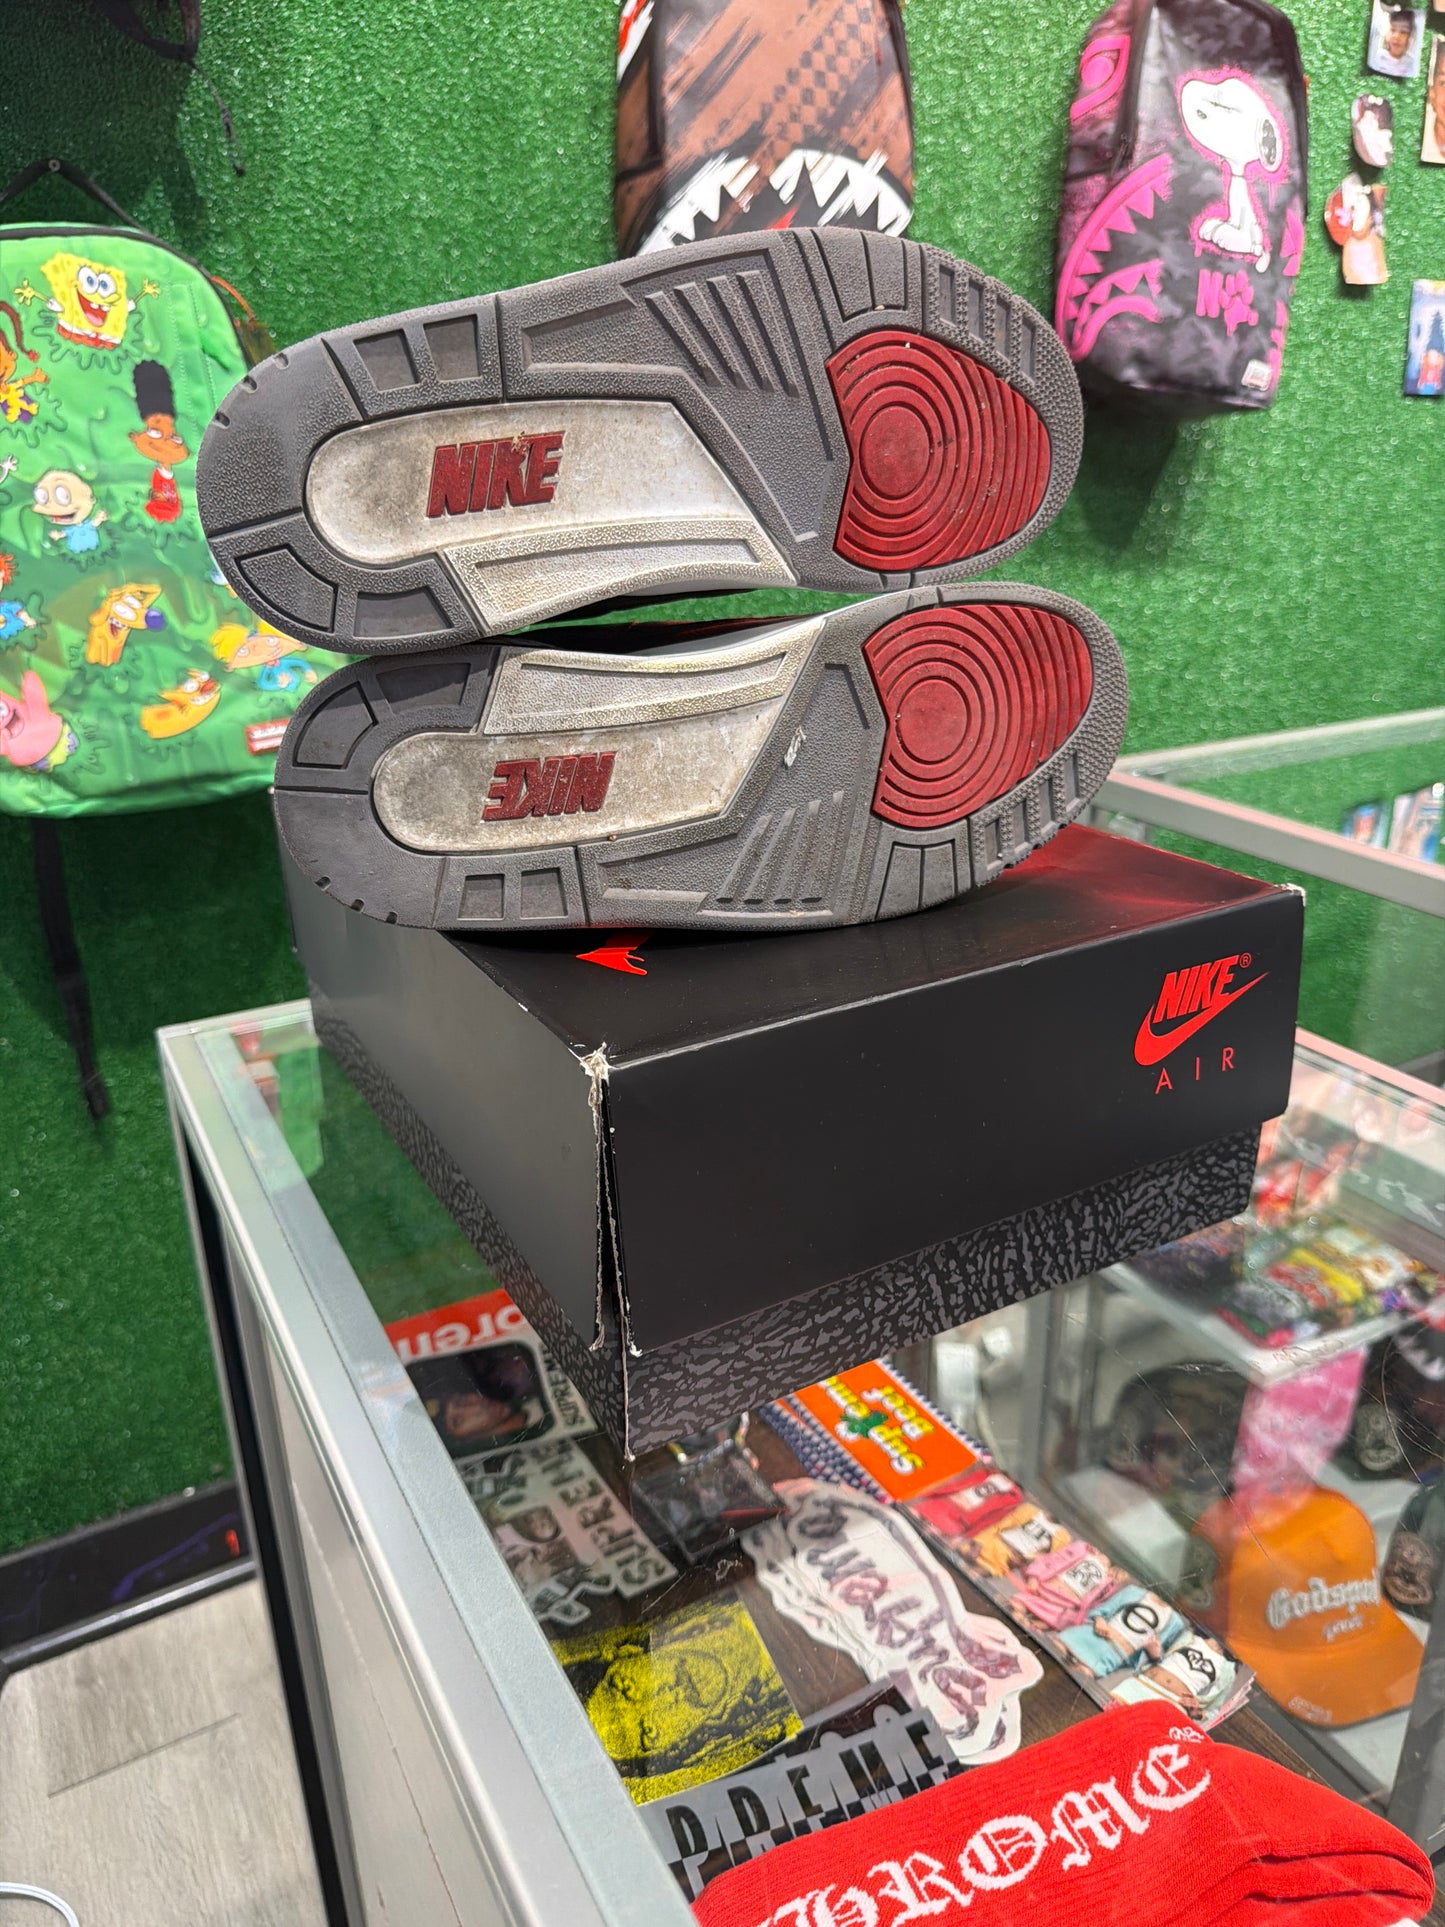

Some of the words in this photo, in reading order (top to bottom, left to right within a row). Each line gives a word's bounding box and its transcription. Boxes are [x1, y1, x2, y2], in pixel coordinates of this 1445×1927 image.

[426, 430, 565, 518] NIKE
[482, 751, 617, 821] NIKE
[1155, 1047, 1235, 1094] AIR
[861, 1384, 936, 1440] Beef
[1121, 1603, 1160, 1635] e
